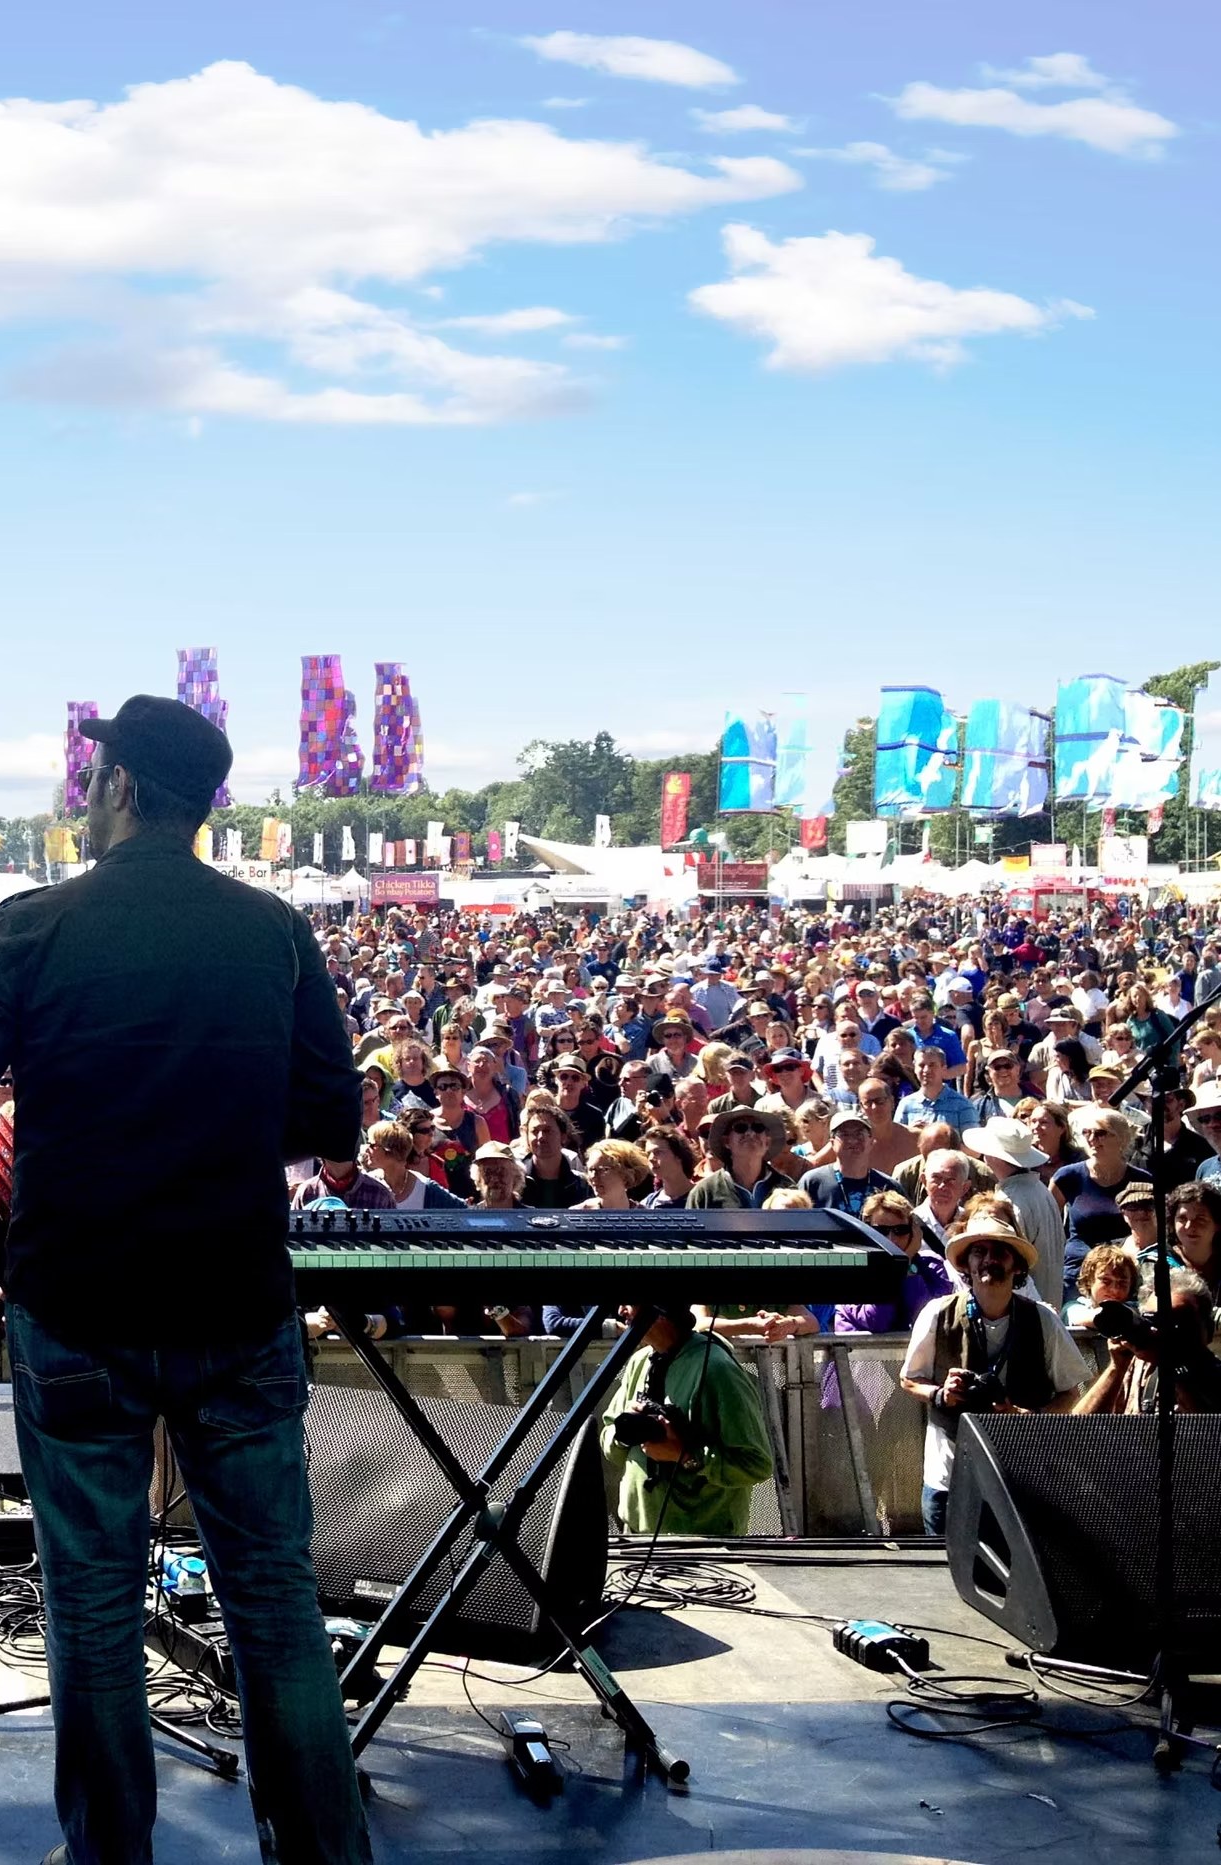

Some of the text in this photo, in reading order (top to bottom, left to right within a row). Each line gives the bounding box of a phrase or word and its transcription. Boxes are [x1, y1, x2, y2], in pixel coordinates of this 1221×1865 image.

[221, 865, 267, 878] odle Bar
[412, 880, 436, 889] Tikka
[355, 1580, 372, 1588] d&b
